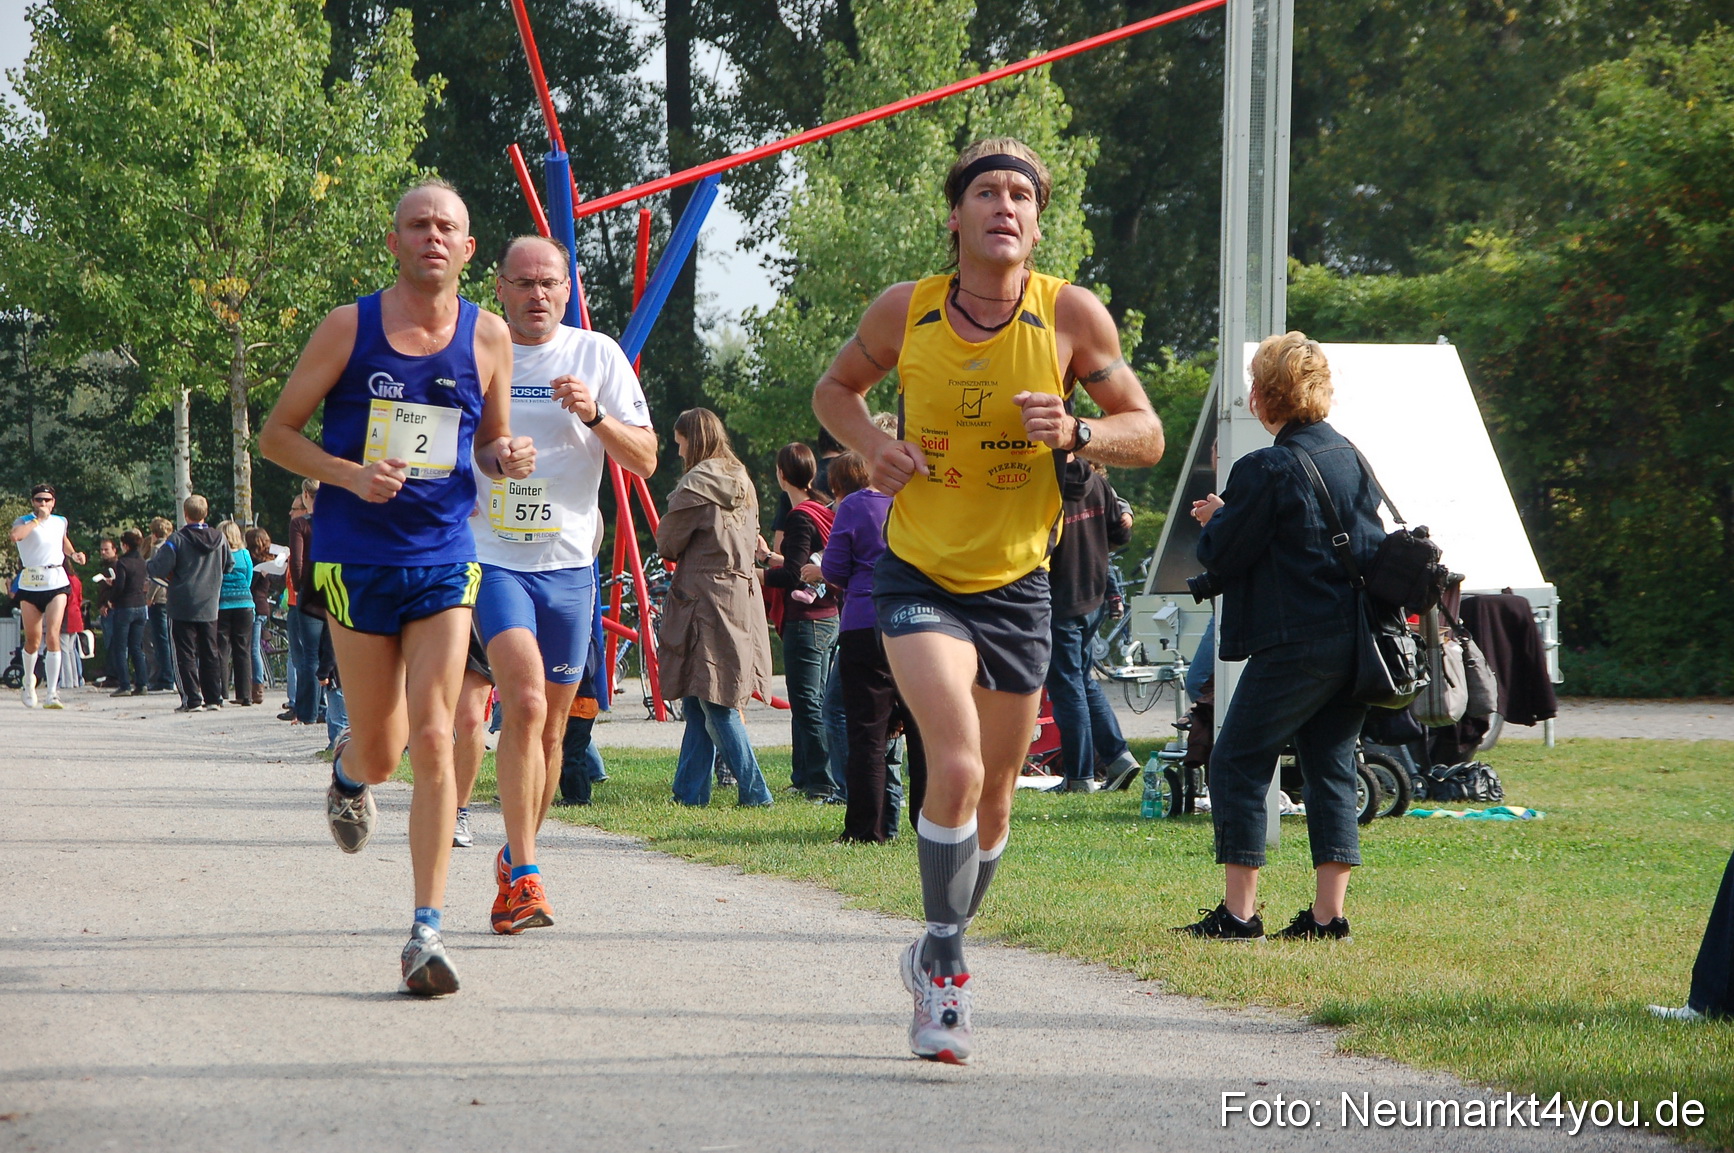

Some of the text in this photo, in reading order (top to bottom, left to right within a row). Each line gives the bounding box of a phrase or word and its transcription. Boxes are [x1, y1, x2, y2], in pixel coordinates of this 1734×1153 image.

[395, 408, 427, 424] Peter
[371, 428, 378, 438] A
[414, 434, 428, 453] 2
[921, 435, 949, 451] Seidl
[988, 462, 1032, 476] PIZZERIA
[997, 472, 1027, 484] ELIO
[509, 481, 543, 496] Günter
[492, 499, 498, 508] B
[515, 503, 552, 521] 575
